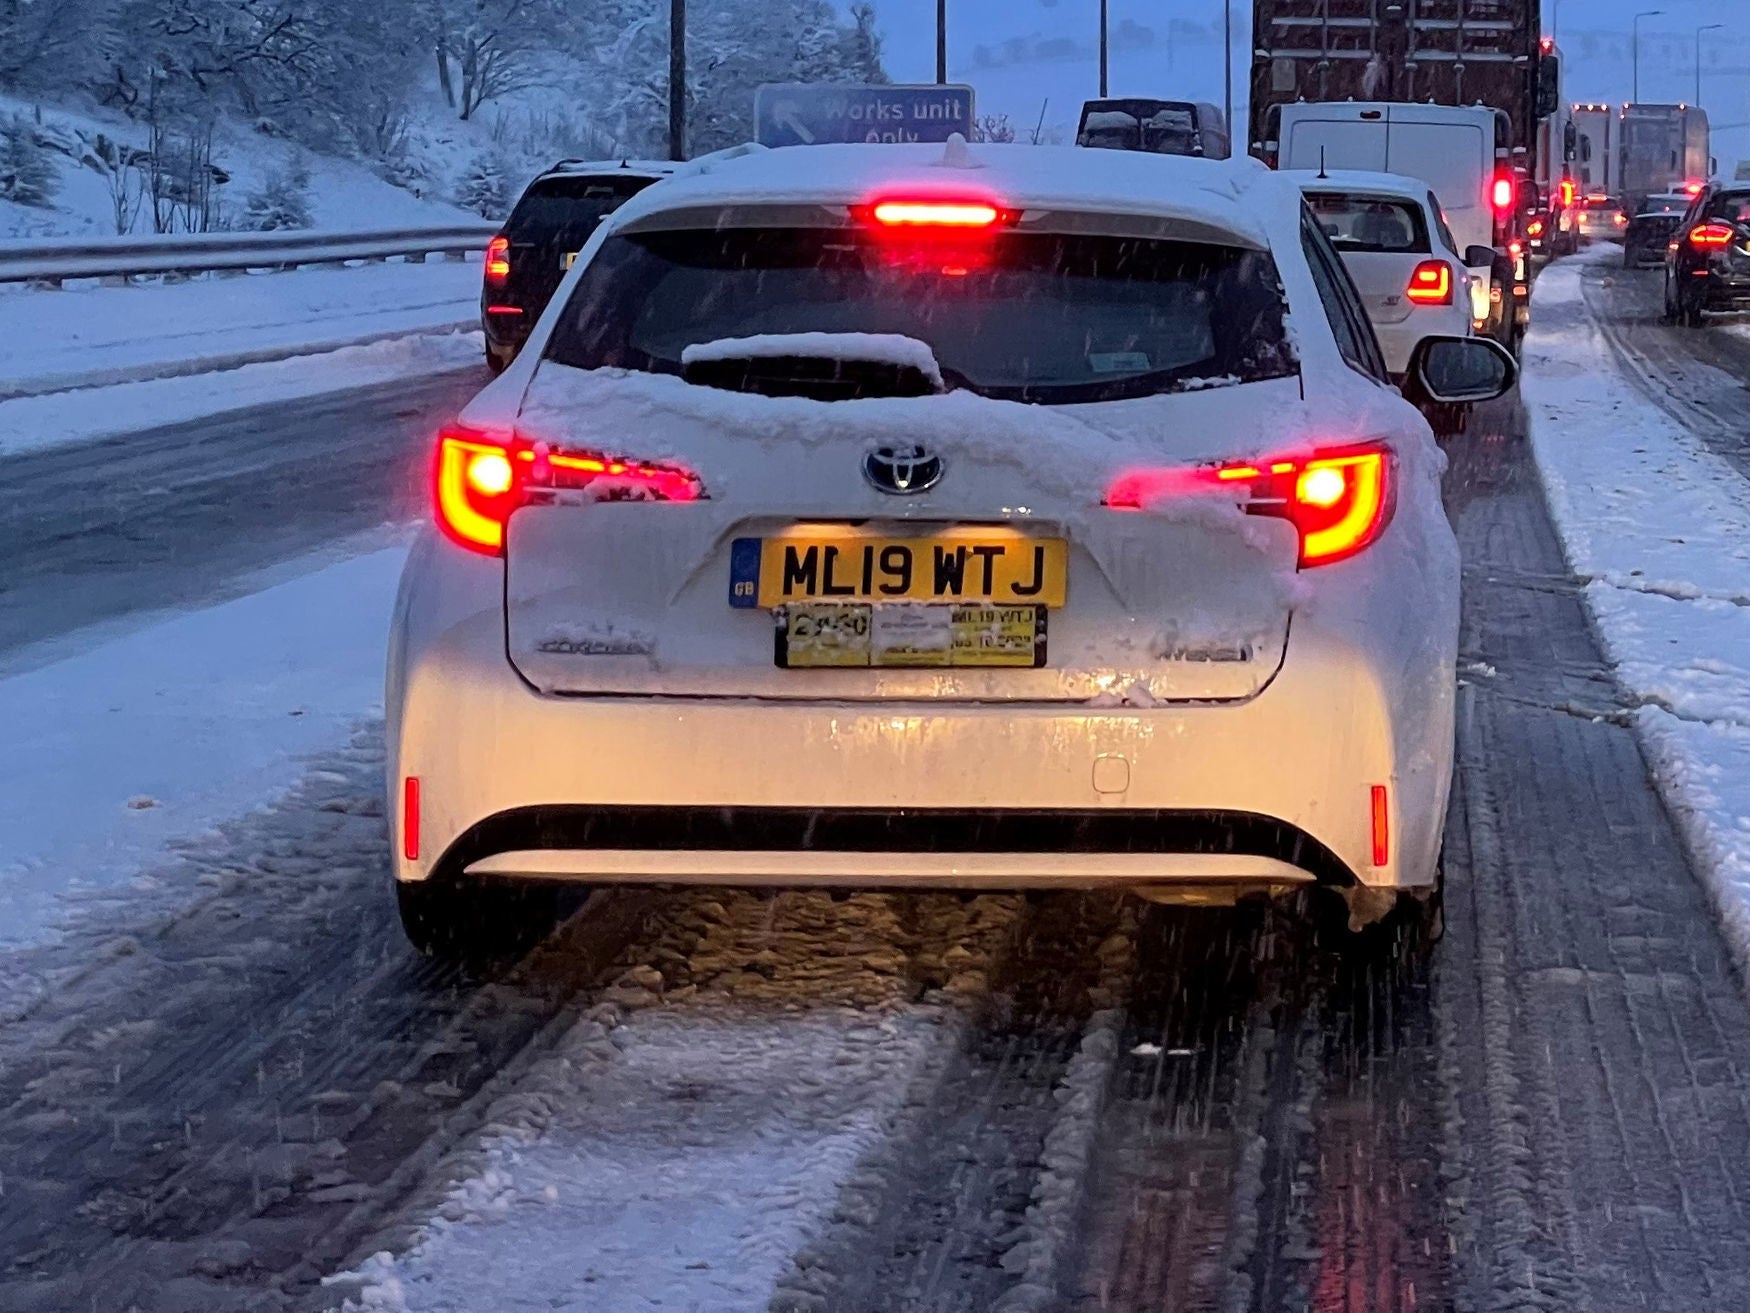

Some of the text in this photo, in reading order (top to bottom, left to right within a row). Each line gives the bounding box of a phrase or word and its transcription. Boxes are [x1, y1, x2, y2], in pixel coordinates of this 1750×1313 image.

[825, 98, 962, 120] Works unit
[782, 545, 1045, 596] ML19 WTJ
[734, 581, 755, 597] GB
